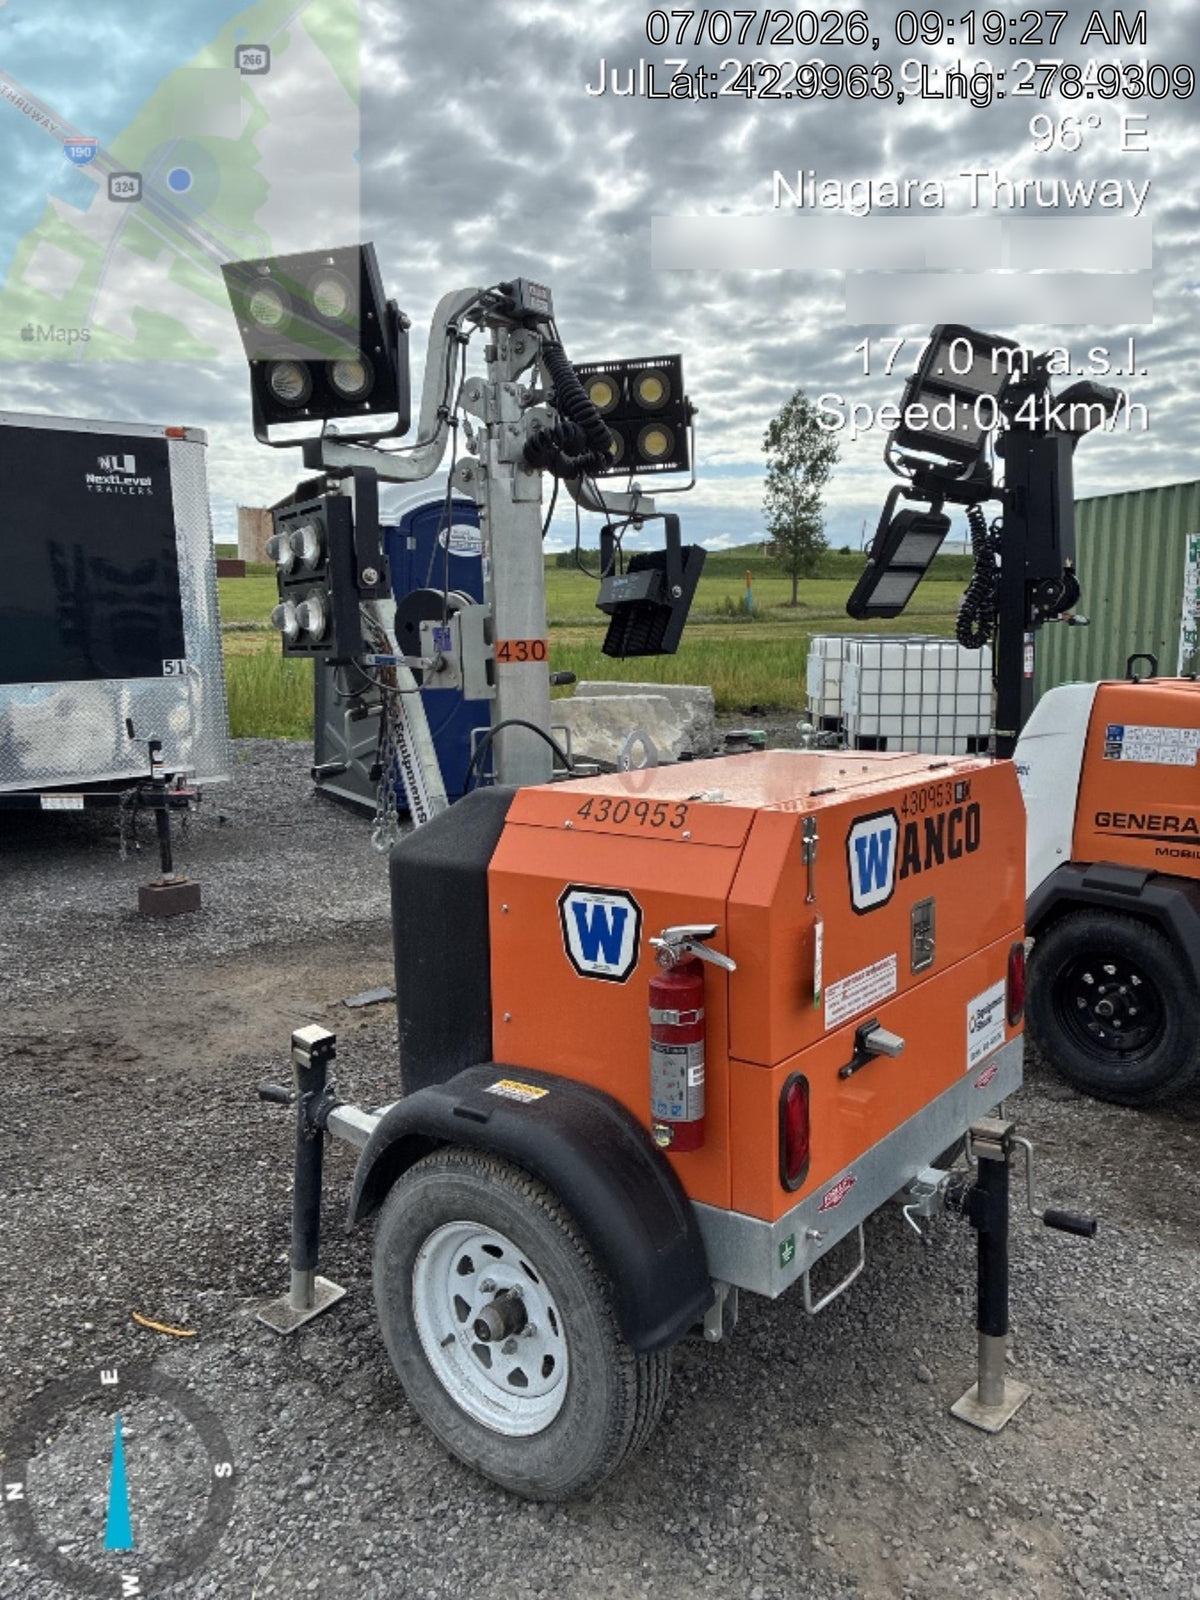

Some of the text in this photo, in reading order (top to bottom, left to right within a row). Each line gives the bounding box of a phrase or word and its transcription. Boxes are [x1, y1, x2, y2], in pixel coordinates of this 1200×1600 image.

[87, 485, 153, 495] TRAILERS
[497, 640, 546, 661] 430
[165, 661, 184, 675] 51
[577, 798, 688, 829] 430953
[571, 901, 628, 965] W
